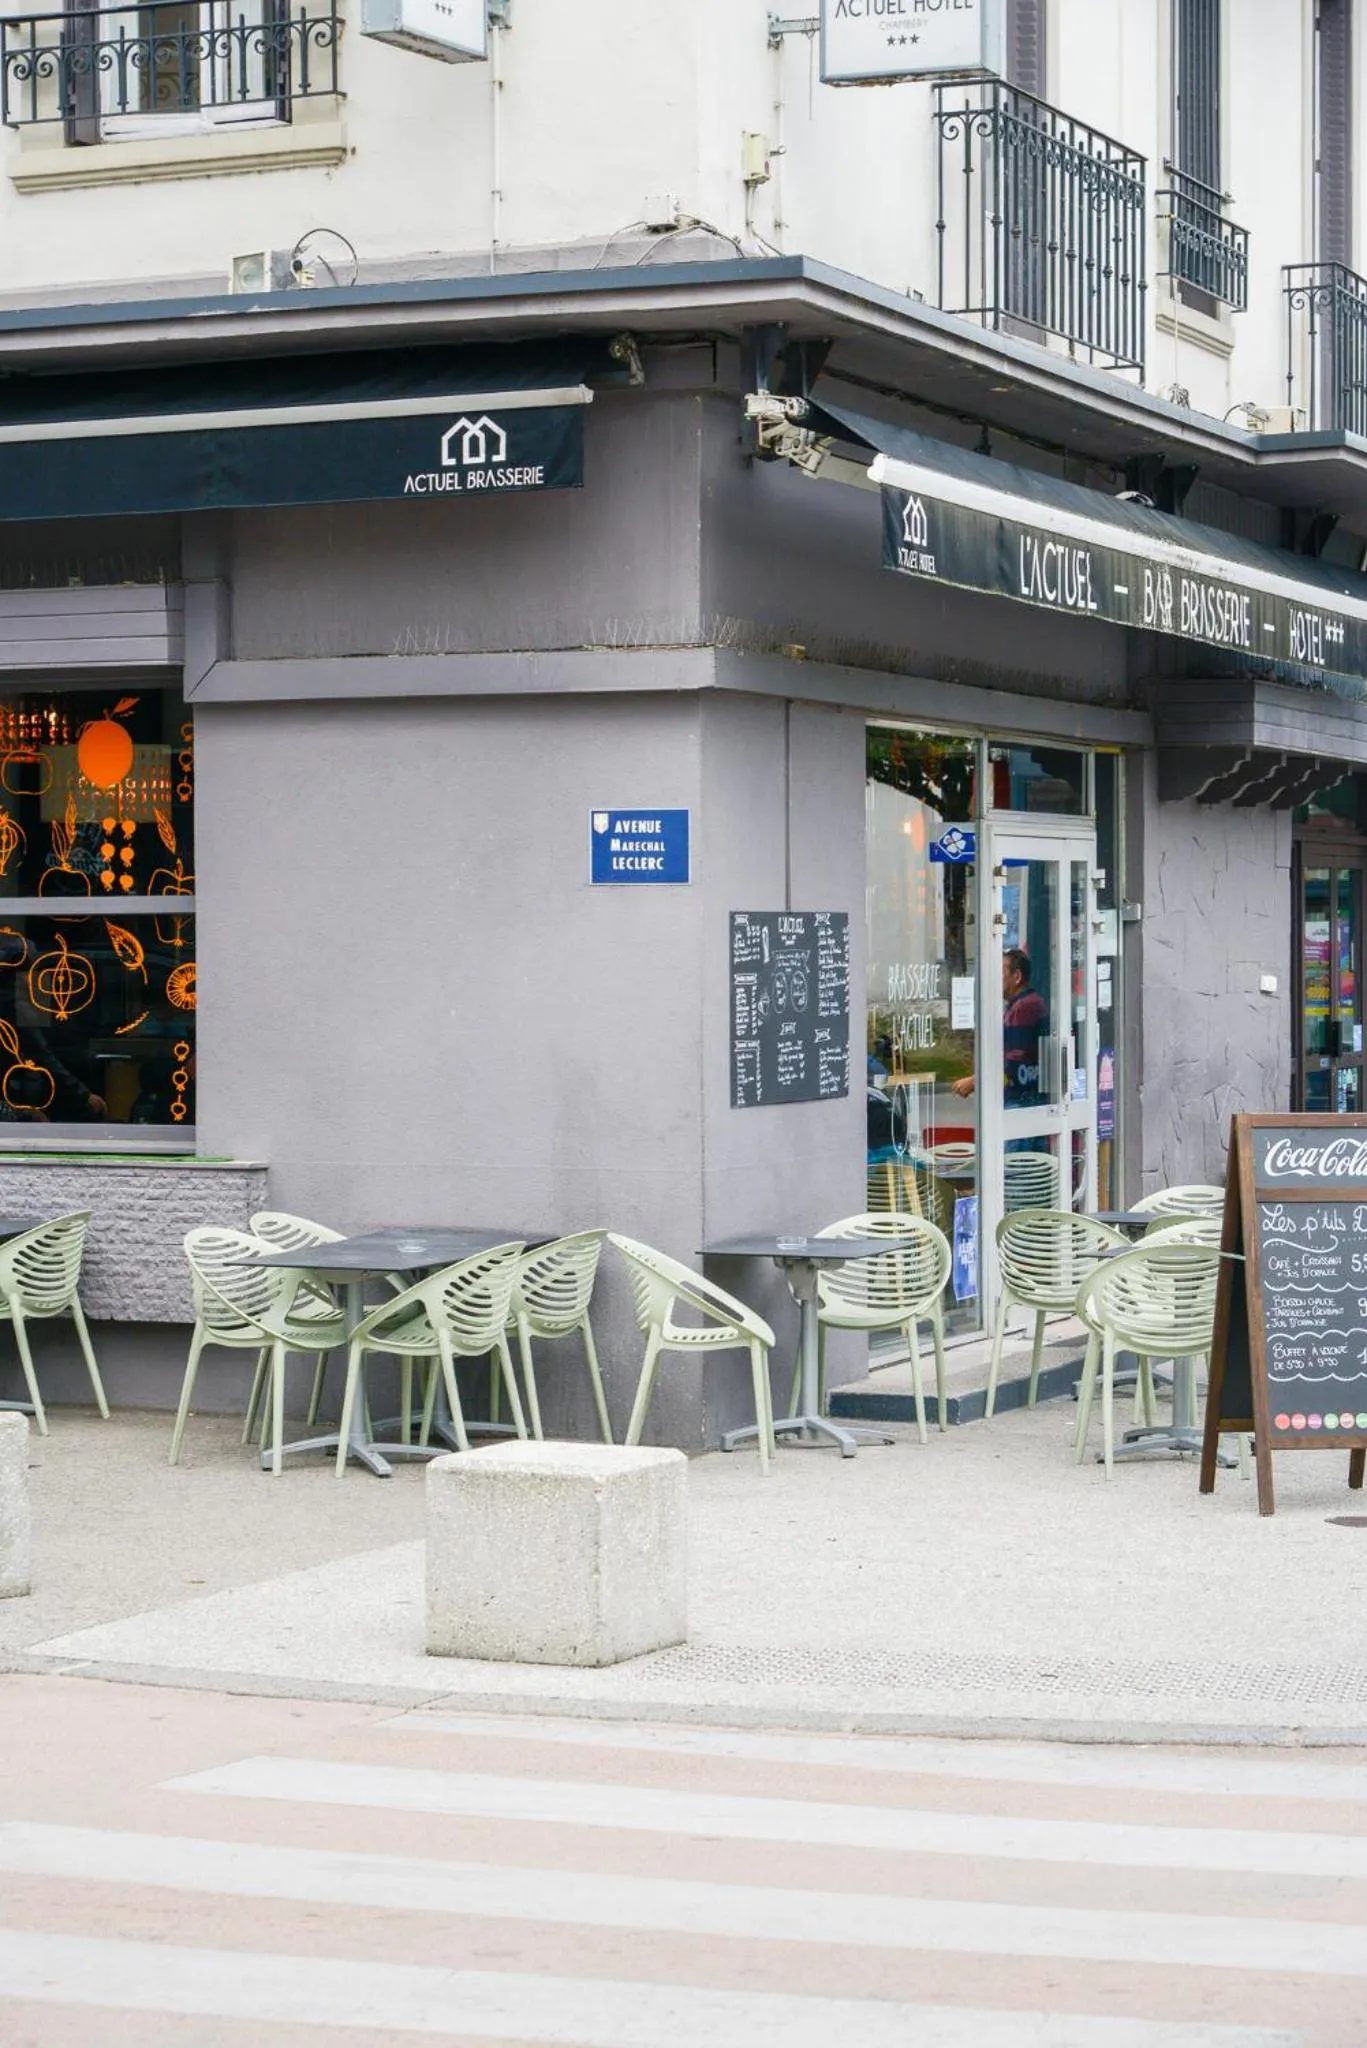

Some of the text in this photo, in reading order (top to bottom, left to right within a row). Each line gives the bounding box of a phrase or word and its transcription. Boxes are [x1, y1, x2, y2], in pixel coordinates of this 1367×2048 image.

[835, 0, 906, 18] ACTUEL
[404, 466, 544, 493] ACTUEL BRASSERIE
[1019, 534, 1097, 610] L'ACTUEL
[1143, 569, 1173, 628] BAR
[1180, 578, 1251, 647] BRASSERIE
[614, 820, 662, 834] AVENUE
[612, 856, 665, 870] LECLERC
[888, 963, 941, 1003] BRASSERIE
[892, 1012, 936, 1051] L'ACTUEL
[1261, 1204, 1297, 1233] Les
[1301, 1208, 1346, 1240] p'tits
